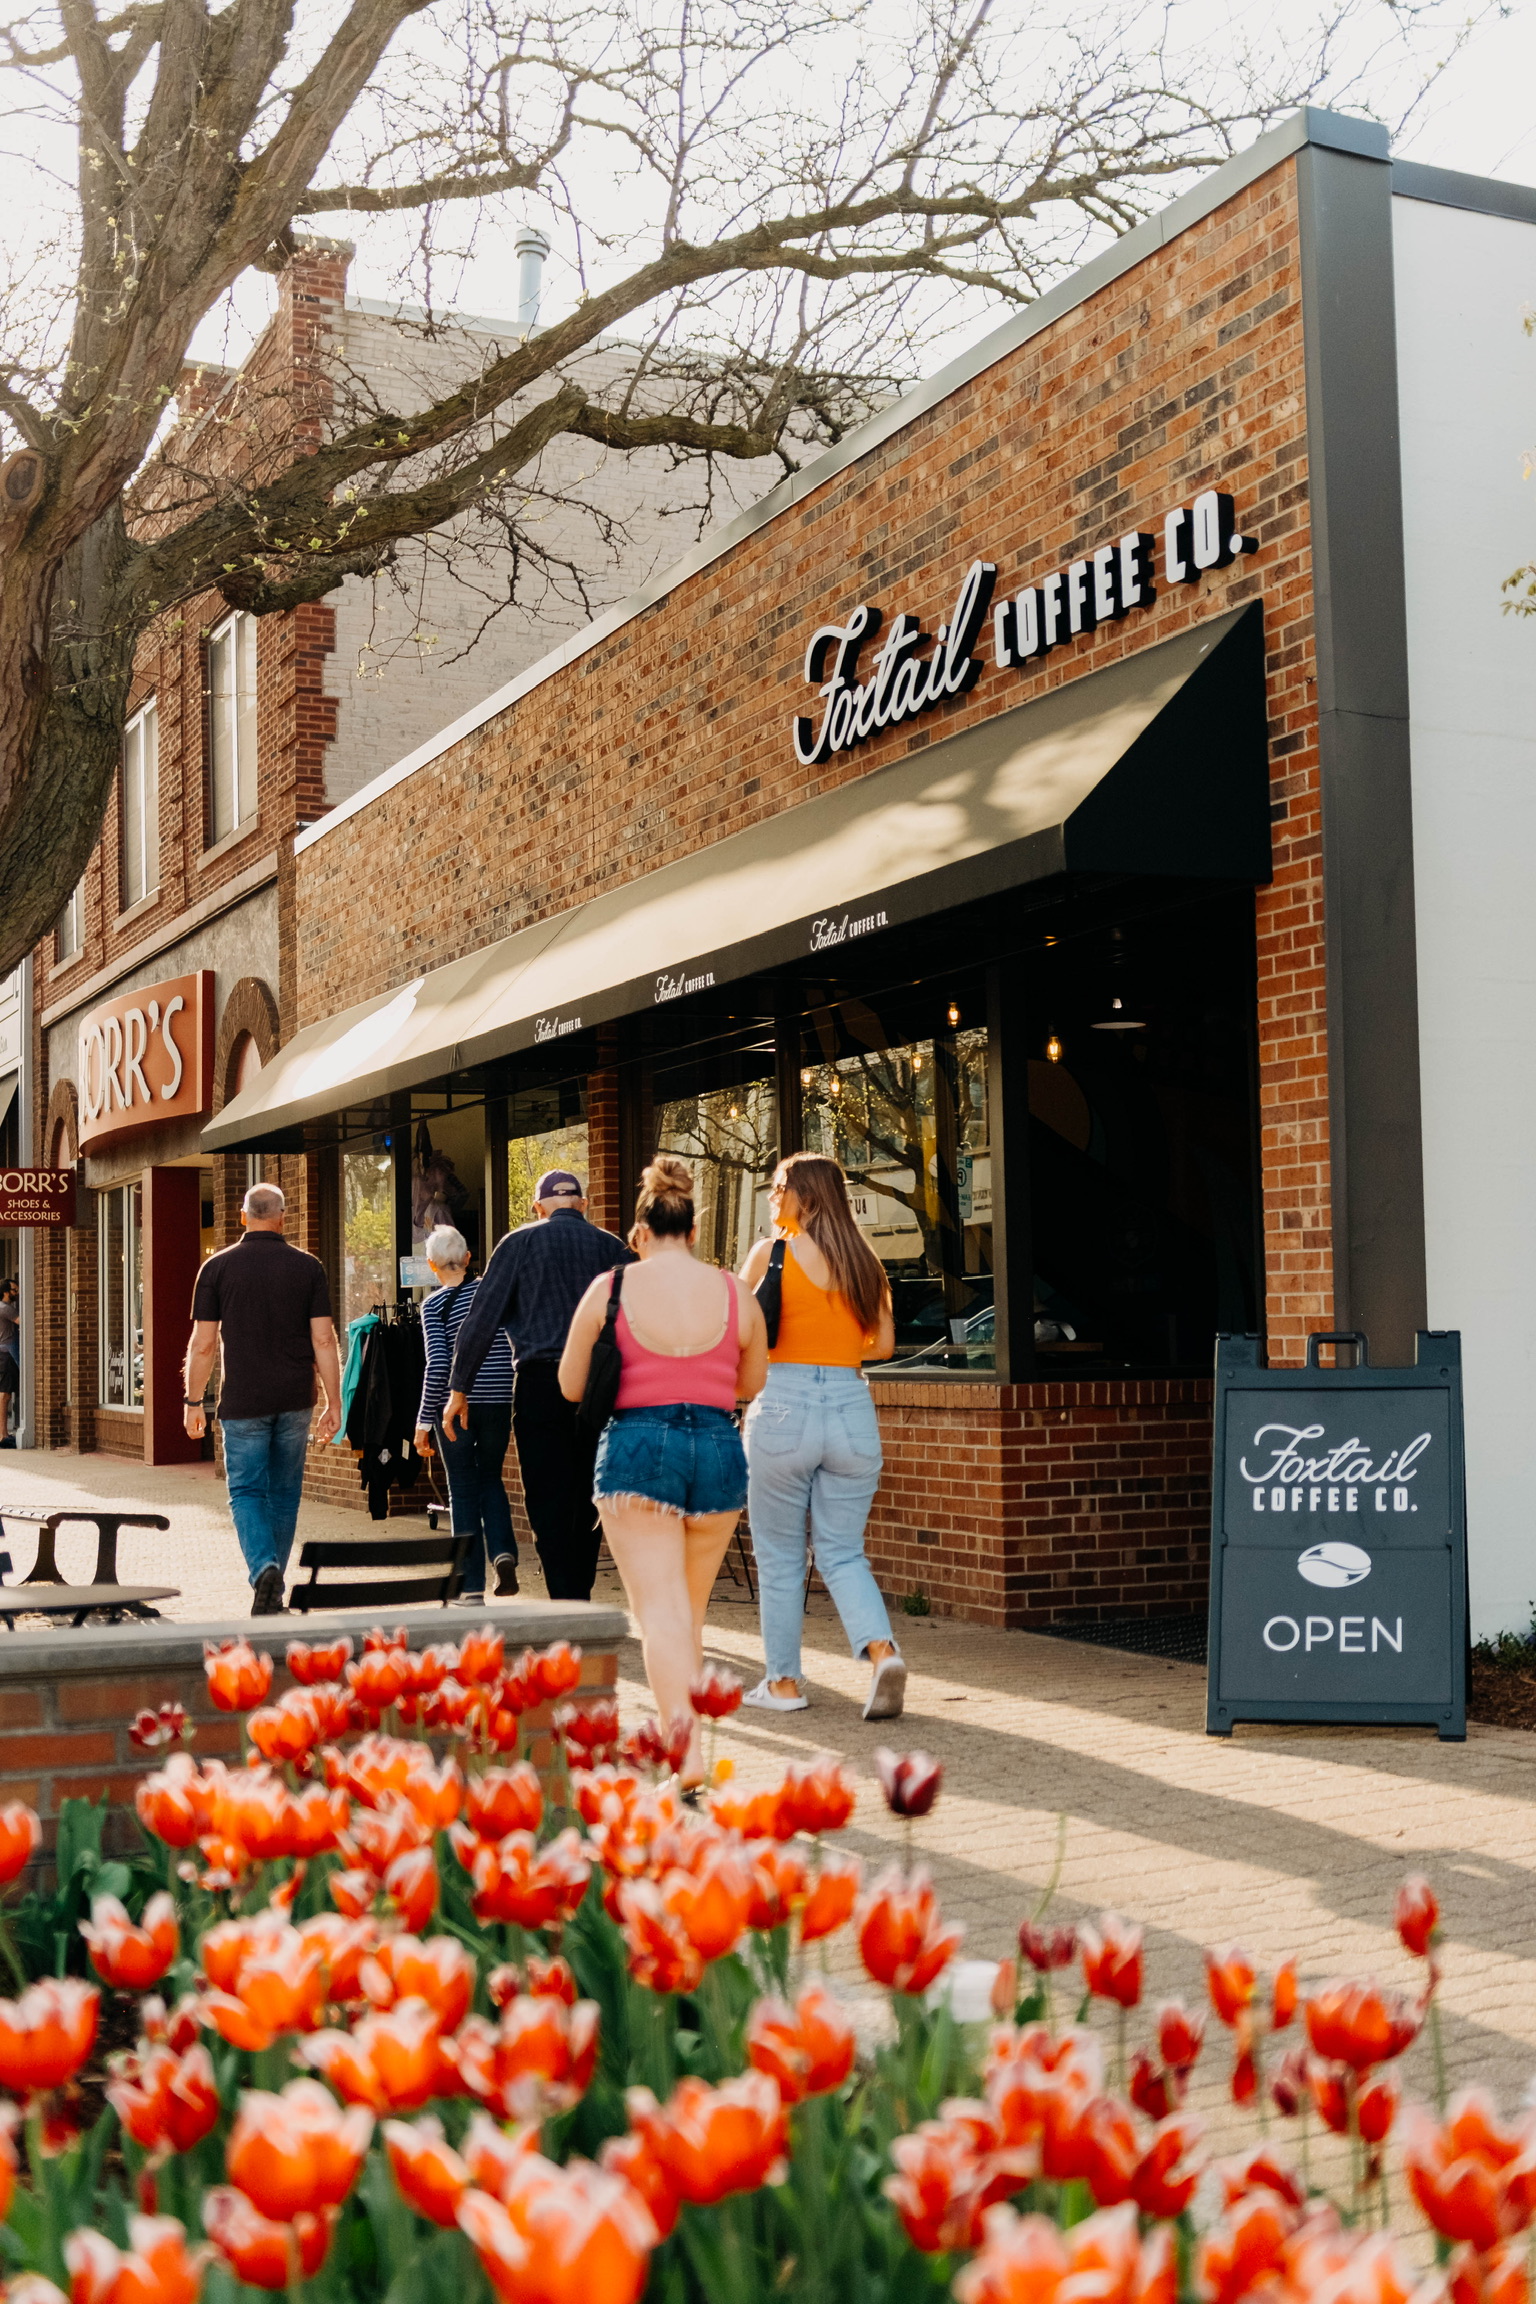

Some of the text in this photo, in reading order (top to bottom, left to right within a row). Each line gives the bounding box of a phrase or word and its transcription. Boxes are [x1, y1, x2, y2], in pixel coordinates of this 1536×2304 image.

[793, 489, 1260, 765] Foxtail COFFEE CO.
[810, 911, 889, 952] Foxtail COFFEE CO.
[685, 975, 705, 993] COFFEE
[0, 1172, 69, 1193] ORR'S
[7, 1199, 51, 1209] SHOES &
[1240, 1423, 1431, 1483] Foxtail
[1253, 1487, 1418, 1512] COFFEE CO.
[1262, 1615, 1403, 1653] OPEN
